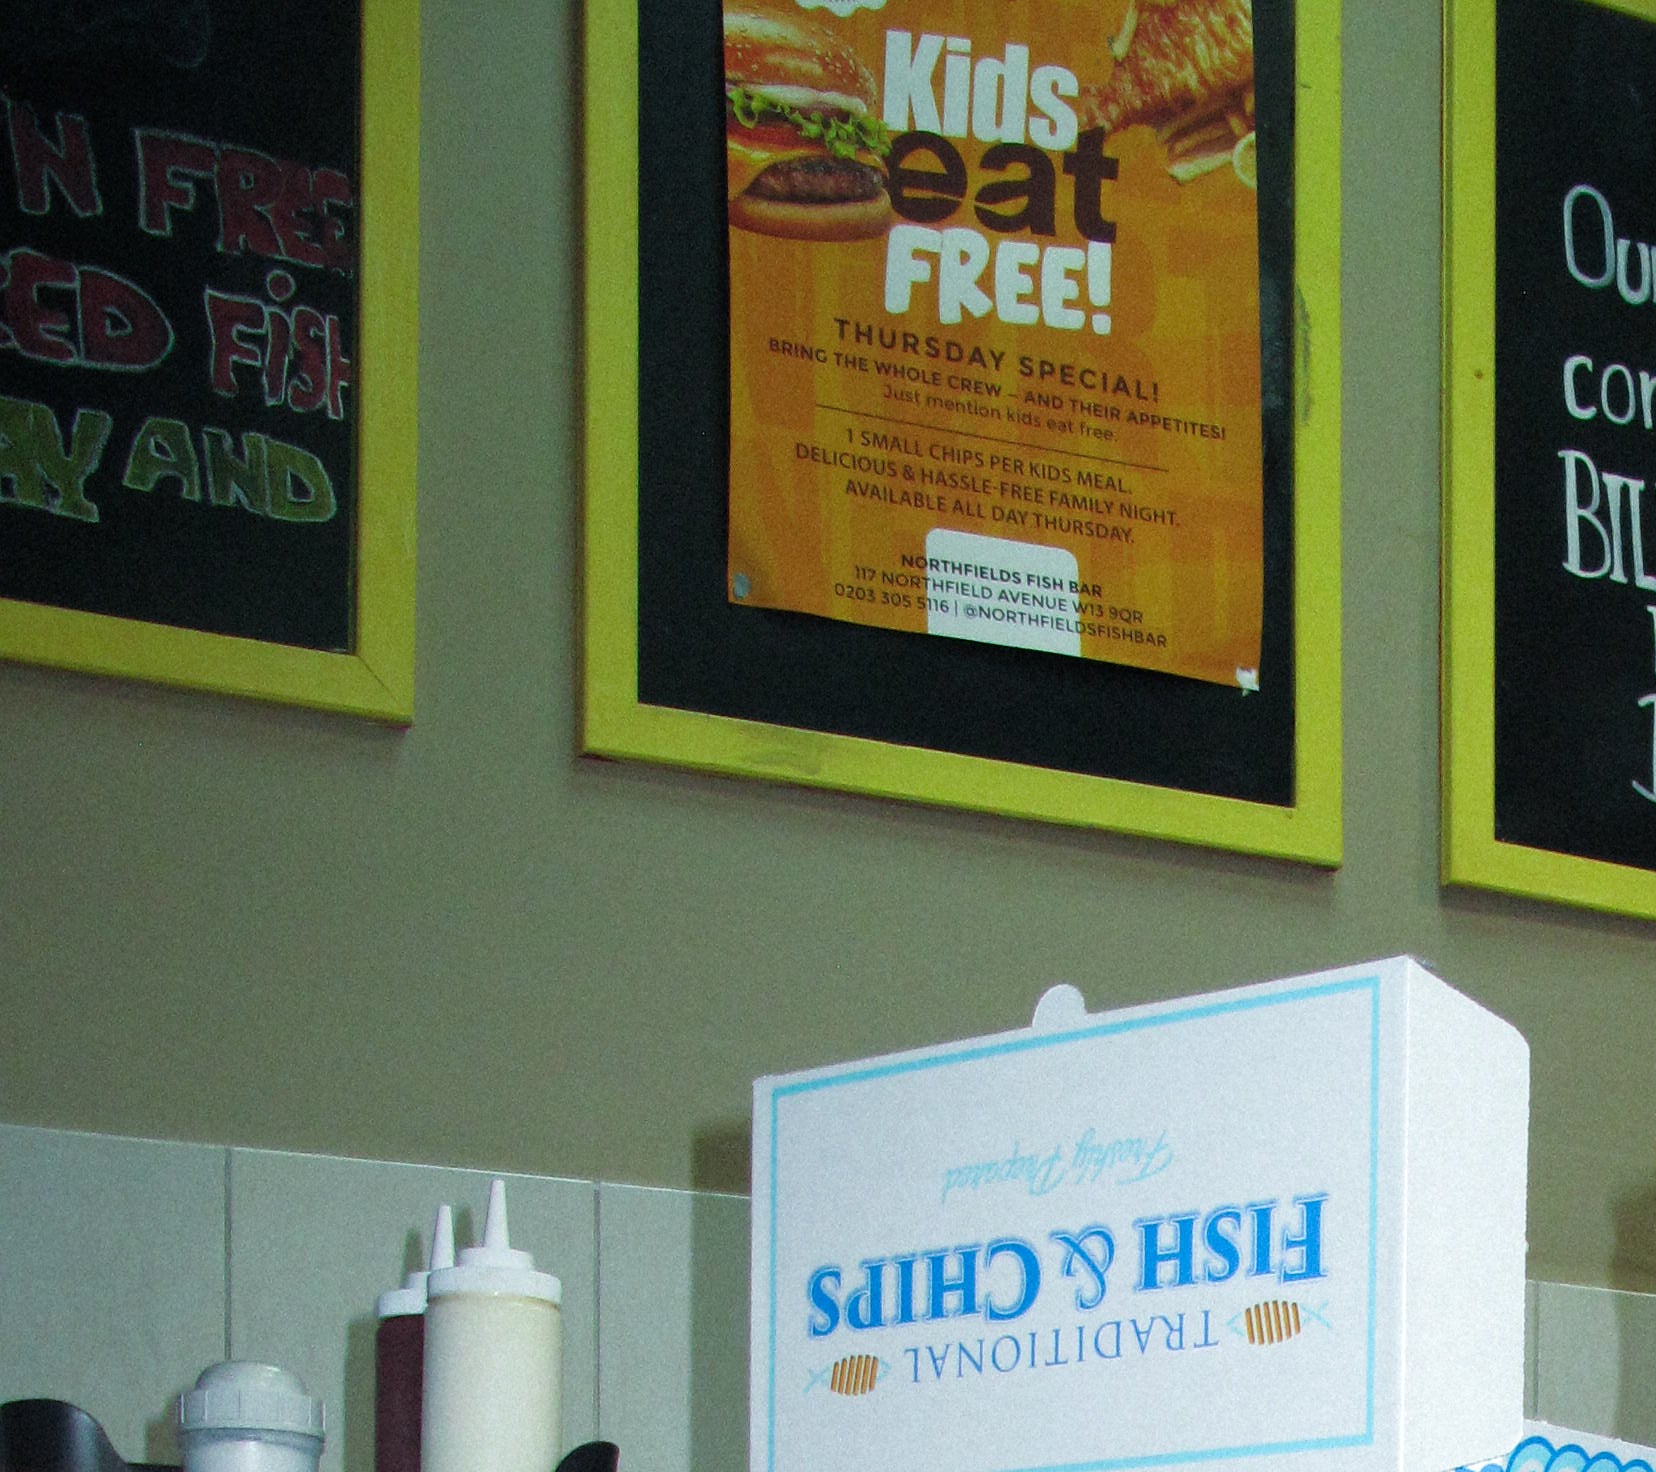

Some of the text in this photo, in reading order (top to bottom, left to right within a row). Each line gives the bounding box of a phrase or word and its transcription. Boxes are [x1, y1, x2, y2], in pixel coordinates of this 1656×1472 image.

[882, 30, 1079, 151] Kids
[889, 127, 1119, 243] eat
[0, 248, 175, 373] ED
[884, 224, 1112, 335] FREE!
[769, 337, 827, 363] BRING
[833, 352, 868, 372] THE
[874, 360, 941, 386] WHOLE
[949, 375, 1002, 397] CREW
[1025, 391, 1063, 410] AND
[1070, 400, 1120, 421] THEIR
[1127, 411, 1226, 440] APPETITES!
[834, 318, 1159, 403] THURSDAY SPECIAL!
[884, 385, 919, 403] Just
[926, 396, 1000, 419] mention
[1007, 405, 1041, 428] kids
[1047, 418, 1074, 433] eat
[122, 418, 337, 523] AND
[796, 443, 1180, 526] DELICIOUS & HASSLE-FREE FAMILY NIGHT.
[861, 431, 920, 457] SMALL
[929, 444, 984, 466] CHIPS
[991, 456, 1024, 475] PER
[1030, 463, 1071, 482] KIDS
[1077, 471, 1132, 493] MEAL.
[846, 480, 1134, 543] AVAILABLE ALL DAY THURSDAY.
[834, 583, 876, 602] 0203
[881, 590, 912, 608] 305
[917, 596, 950, 613] 5116
[964, 605, 1167, 648] @NORTHFIELDSFISHBAR
[882, 571, 992, 600] NORTHFIELD
[999, 589, 1067, 612] AVENUE
[1073, 602, 1104, 618] W13
[901, 554, 1103, 598] NORTHFIELDS FISH BAR
[941, 1135, 1065, 1205] Prepared
[808, 1192, 1331, 1340] FISH & CHIPS
[904, 1309, 1220, 1383] TRADITIONAL
